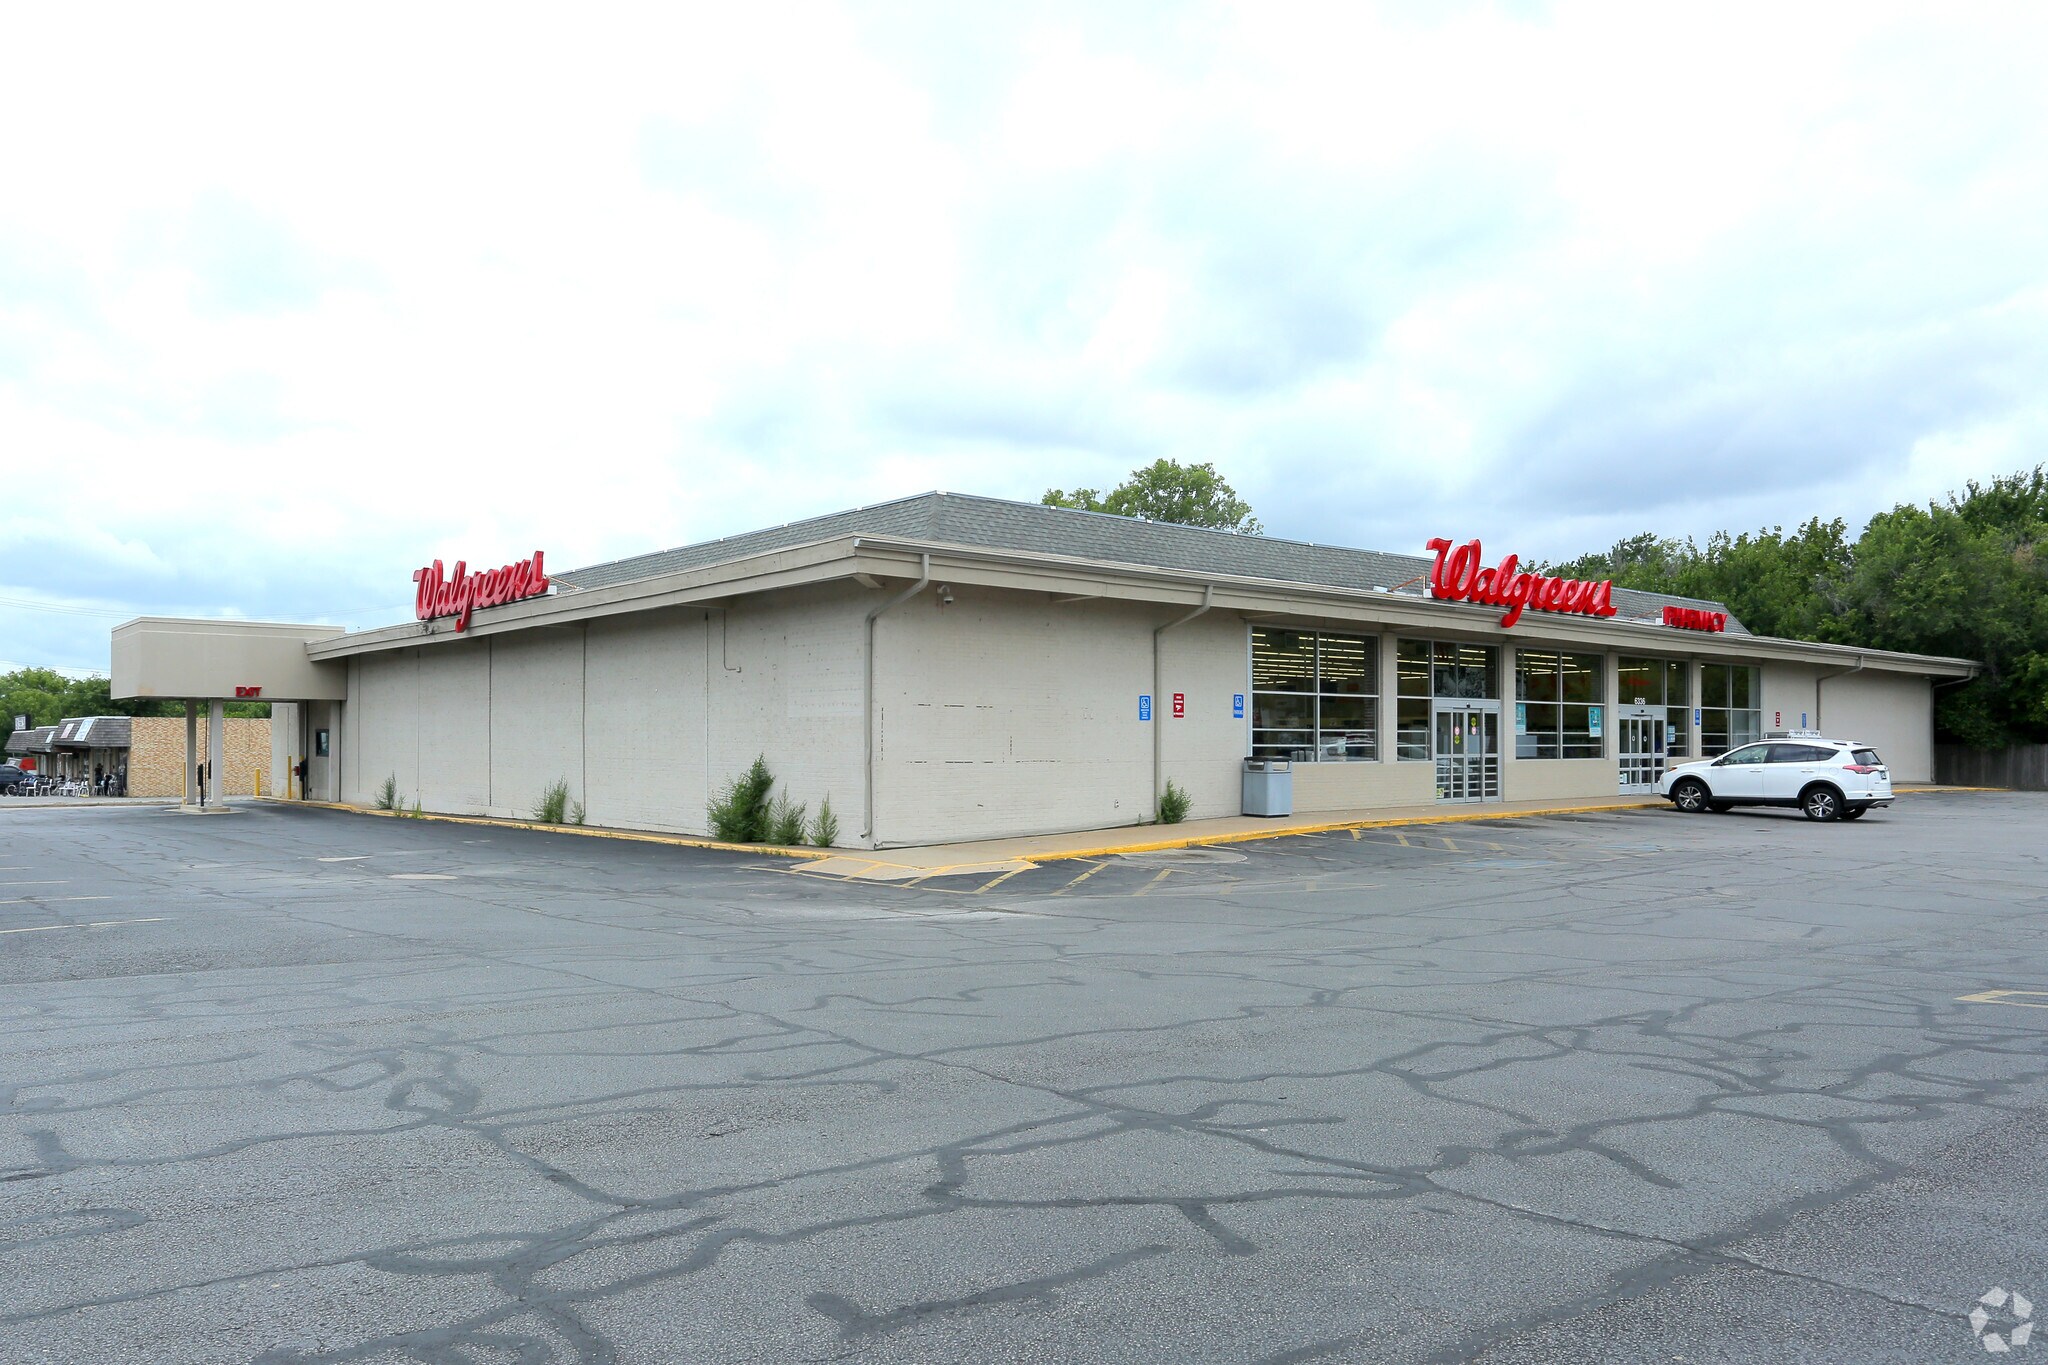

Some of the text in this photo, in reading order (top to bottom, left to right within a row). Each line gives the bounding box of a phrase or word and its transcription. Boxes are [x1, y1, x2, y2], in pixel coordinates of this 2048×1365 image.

[413, 551, 549, 633] Walgreens
[1426, 537, 1617, 628] Walgreens
[235, 685, 262, 697] EXIT
